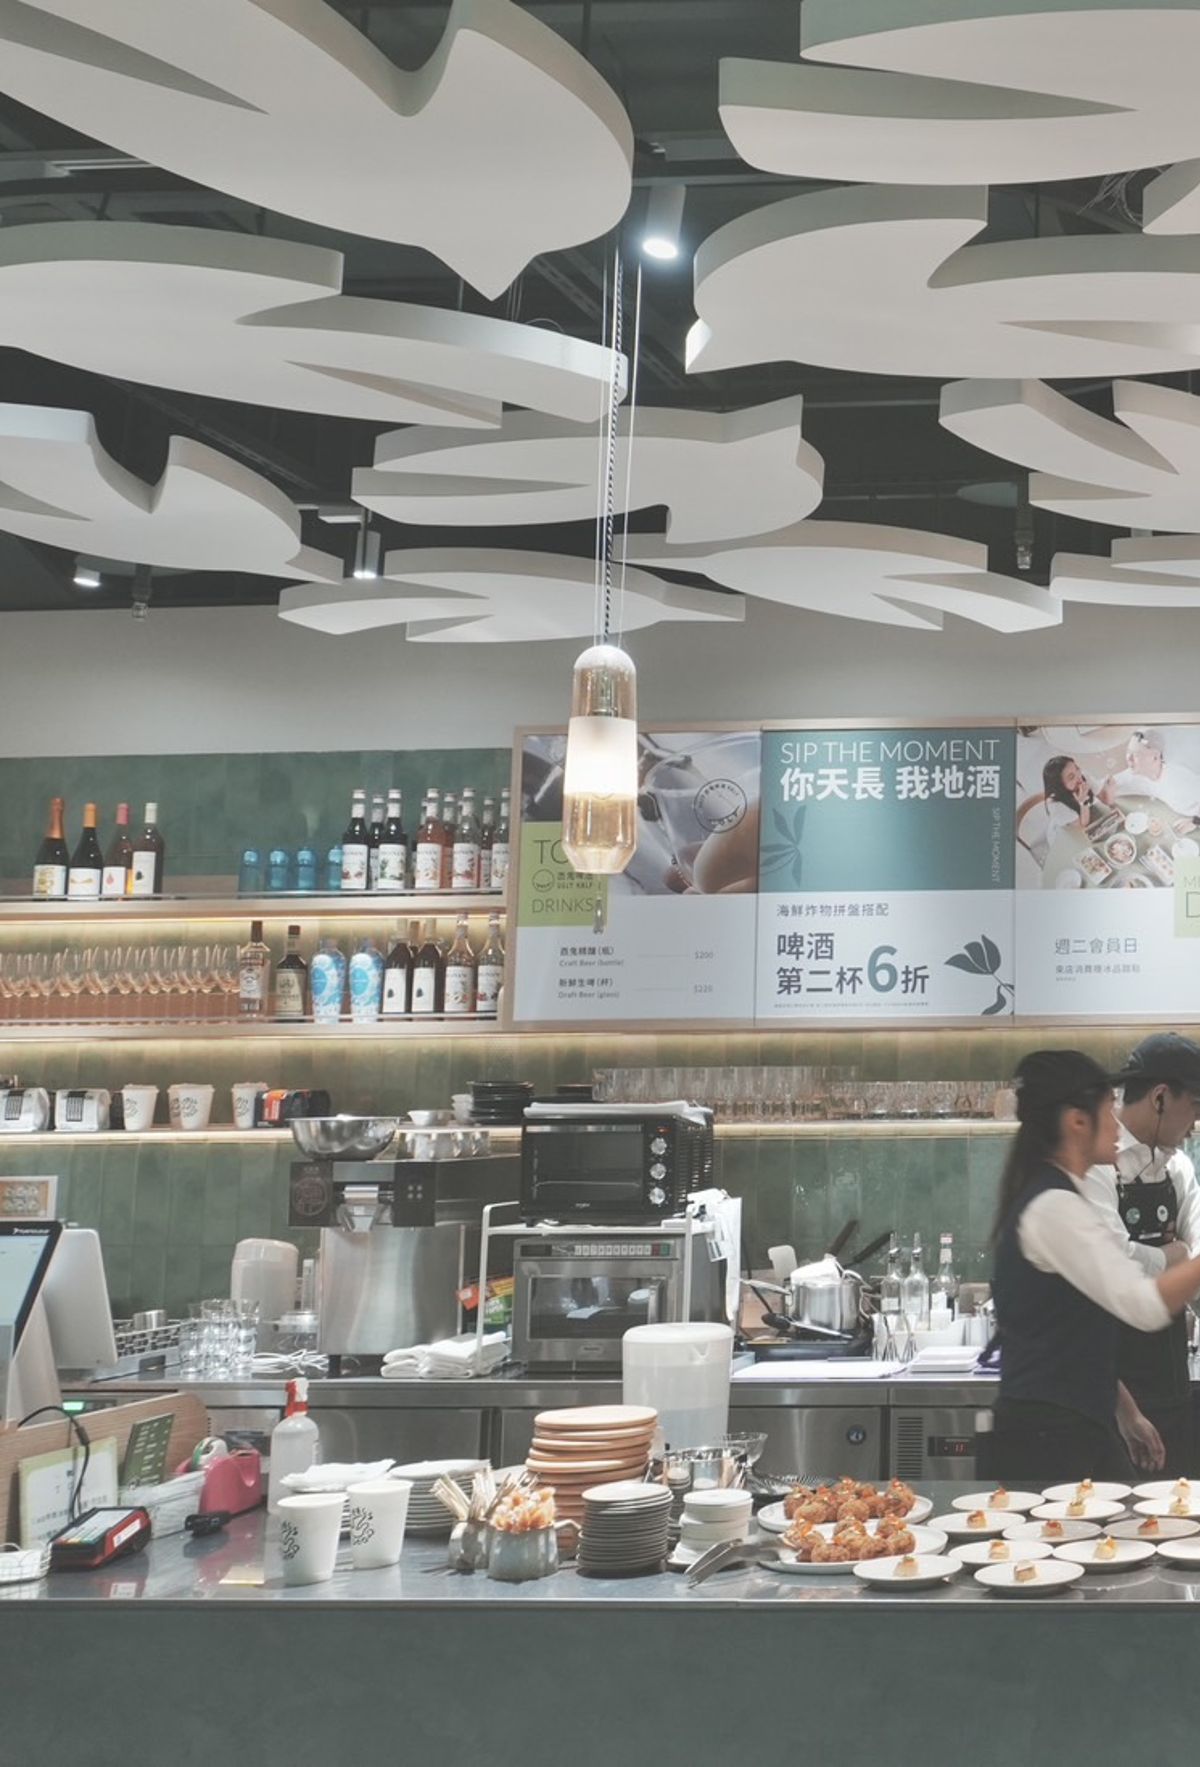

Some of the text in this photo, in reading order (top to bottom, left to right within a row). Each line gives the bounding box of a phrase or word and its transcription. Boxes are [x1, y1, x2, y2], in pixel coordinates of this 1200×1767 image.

[780, 739, 1000, 764] SIP THE MOMENT
[780, 767, 885, 801] 你天長
[895, 765, 1000, 800] 我地酒
[532, 898, 593, 913] DRINKS
[777, 903, 889, 917] 海鮮炸物拼盤搭配
[777, 932, 835, 961] 啤酒
[1055, 938, 1137, 955] 週二會員日
